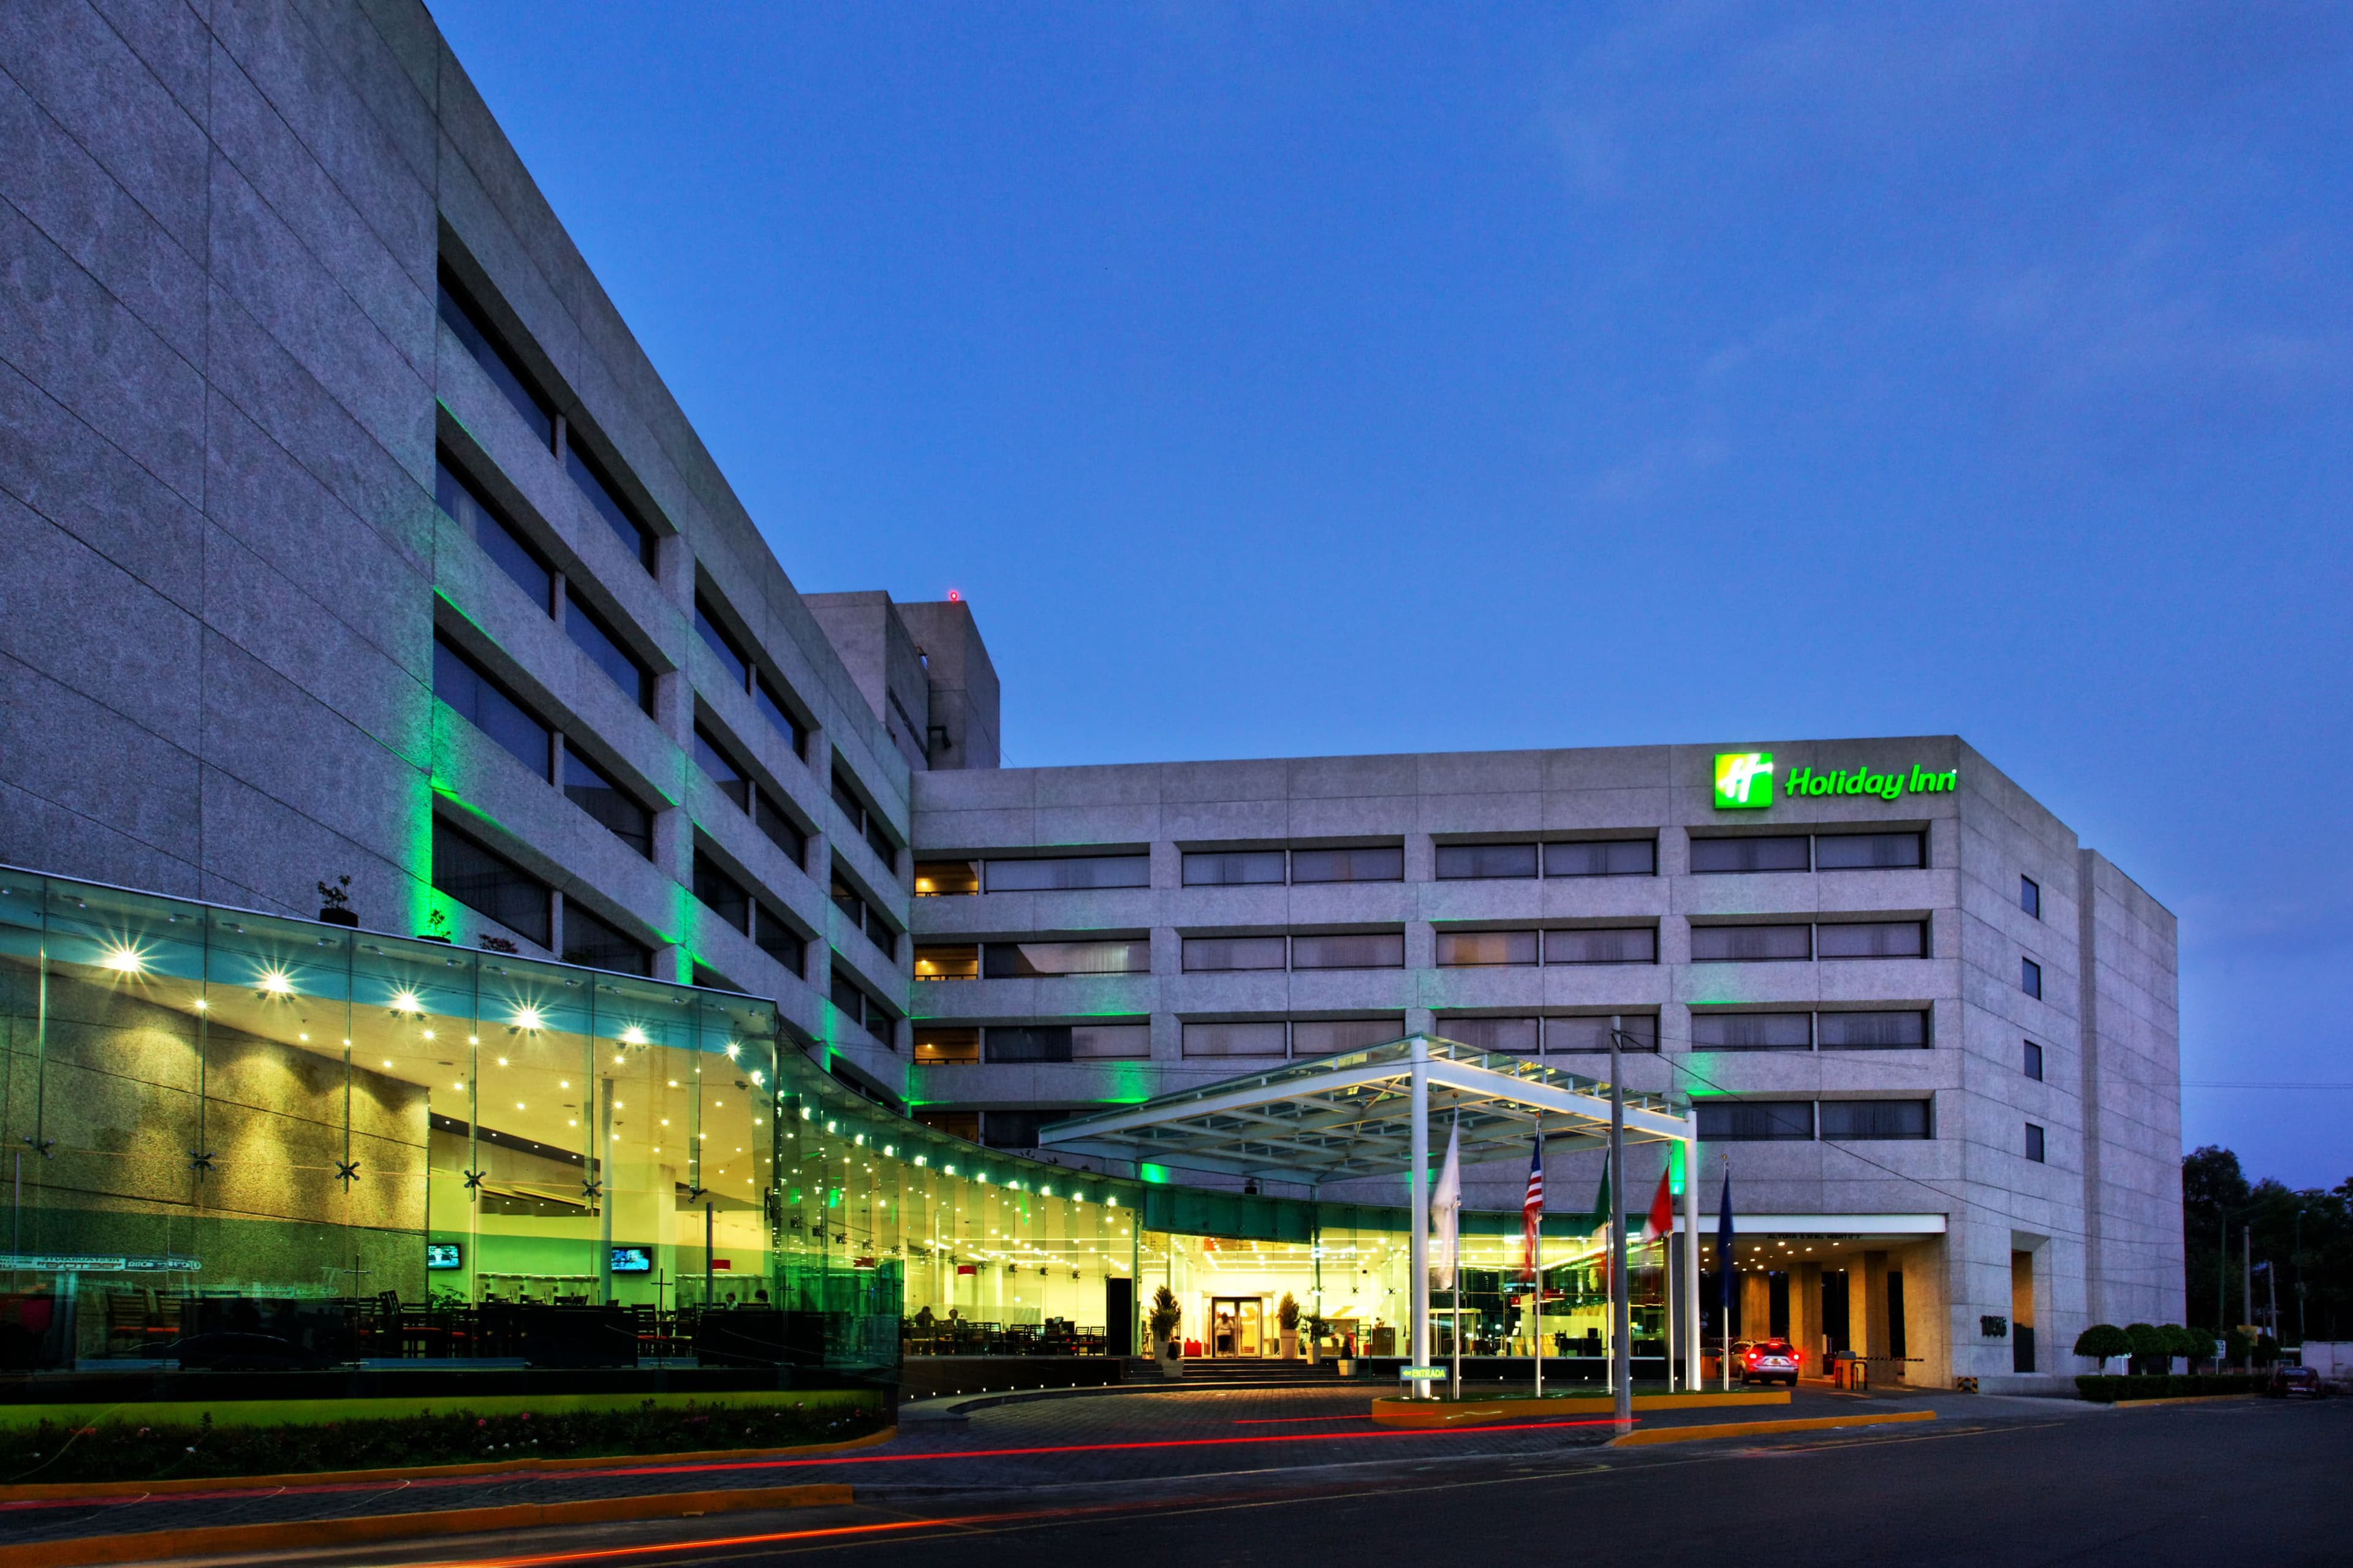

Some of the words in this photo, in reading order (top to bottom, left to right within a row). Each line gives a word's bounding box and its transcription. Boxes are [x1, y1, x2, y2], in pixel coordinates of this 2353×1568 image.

[1784, 767, 1904, 800] Holiday
[1909, 764, 1957, 793] Inn
[1411, 1369, 1446, 1378] ENTRADA
